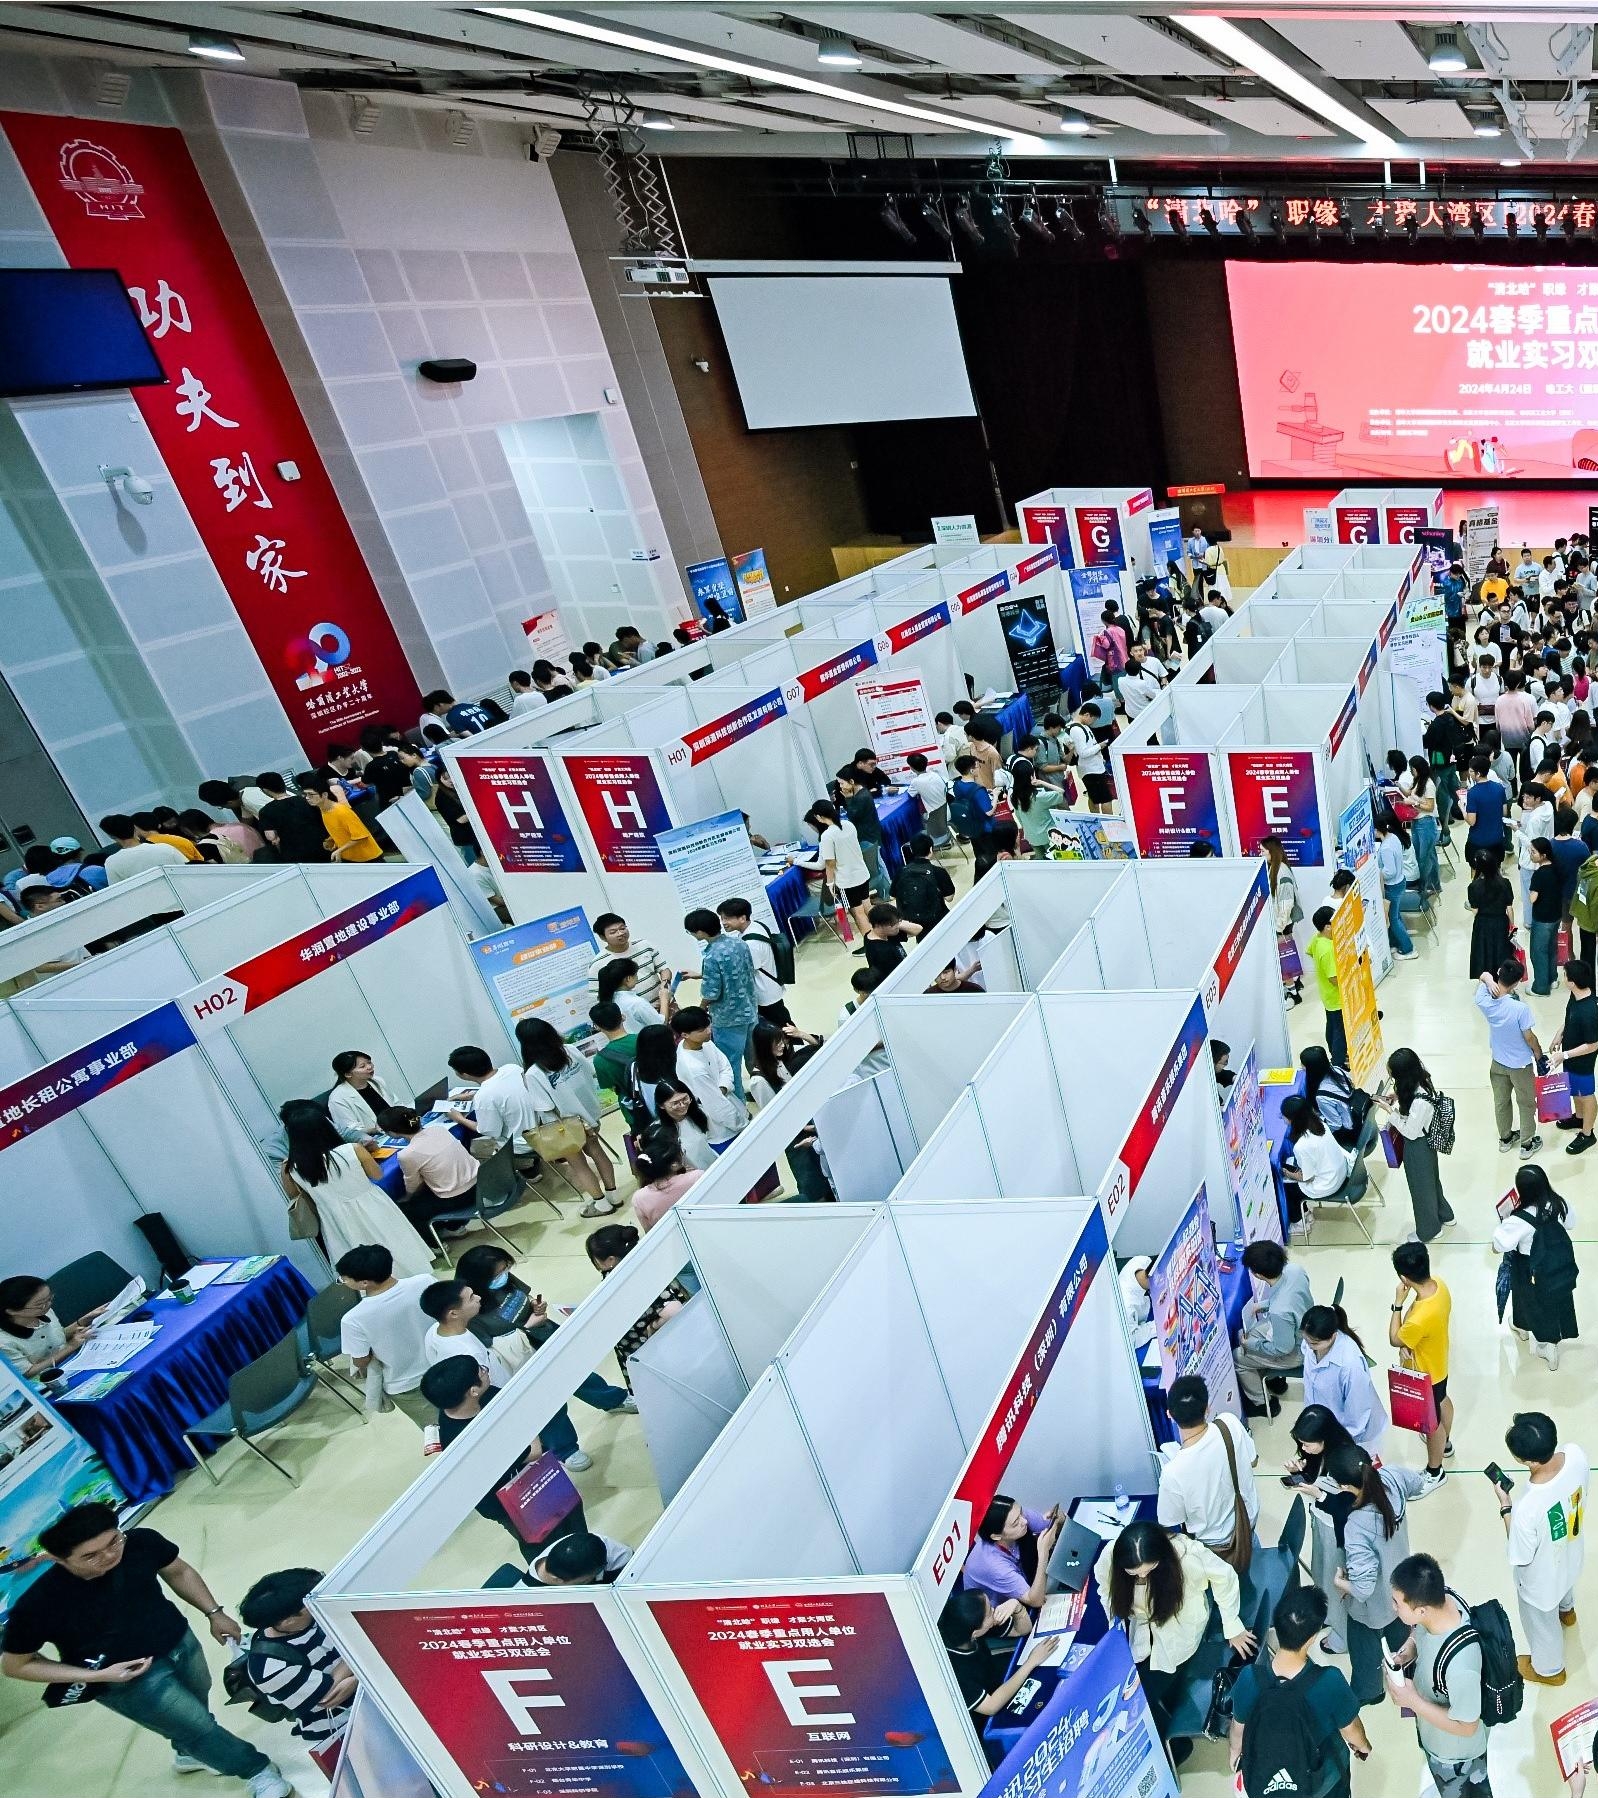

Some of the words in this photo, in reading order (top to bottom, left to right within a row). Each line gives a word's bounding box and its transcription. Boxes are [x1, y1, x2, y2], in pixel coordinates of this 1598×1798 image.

[99, 203, 126, 211] HIT
[1286, 198, 1339, 228] 职缘
[126, 278, 309, 594] 功夫到家
[1091, 525, 1111, 548] G
[1349, 525, 1368, 545] G
[785, 684, 802, 703] G07
[668, 747, 688, 766] H01
[496, 790, 545, 830] H
[601, 790, 648, 830] H
[1158, 786, 1187, 826] F
[1261, 786, 1292, 825] E
[193, 985, 239, 1022] H02
[299, 899, 401, 965] 华润置地建设事业部
[1107, 1172, 1127, 1219] E02
[1150, 1040, 1190, 1126] 腾讯音乐娱乐集团
[933, 1518, 963, 1586] E01
[994, 1251, 1092, 1455] 腾讯科技（深圳）有限公司
[418, 1635, 572, 1651] 2024春季重点用人单位
[707, 1625, 857, 1641] 2024春季重点用人单位
[738, 1637, 836, 1651] 就业实习双选会
[451, 1646, 552, 1661] 就业实习双选会
[480, 1668, 566, 1736] F
[761, 1658, 857, 1727] E
[507, 1738, 609, 1752] 科研设计&教育
[806, 1731, 852, 1742] 互联网
[1021, 1704, 1079, 1776] 2024
[1262, 1777, 1298, 1795] adidas
